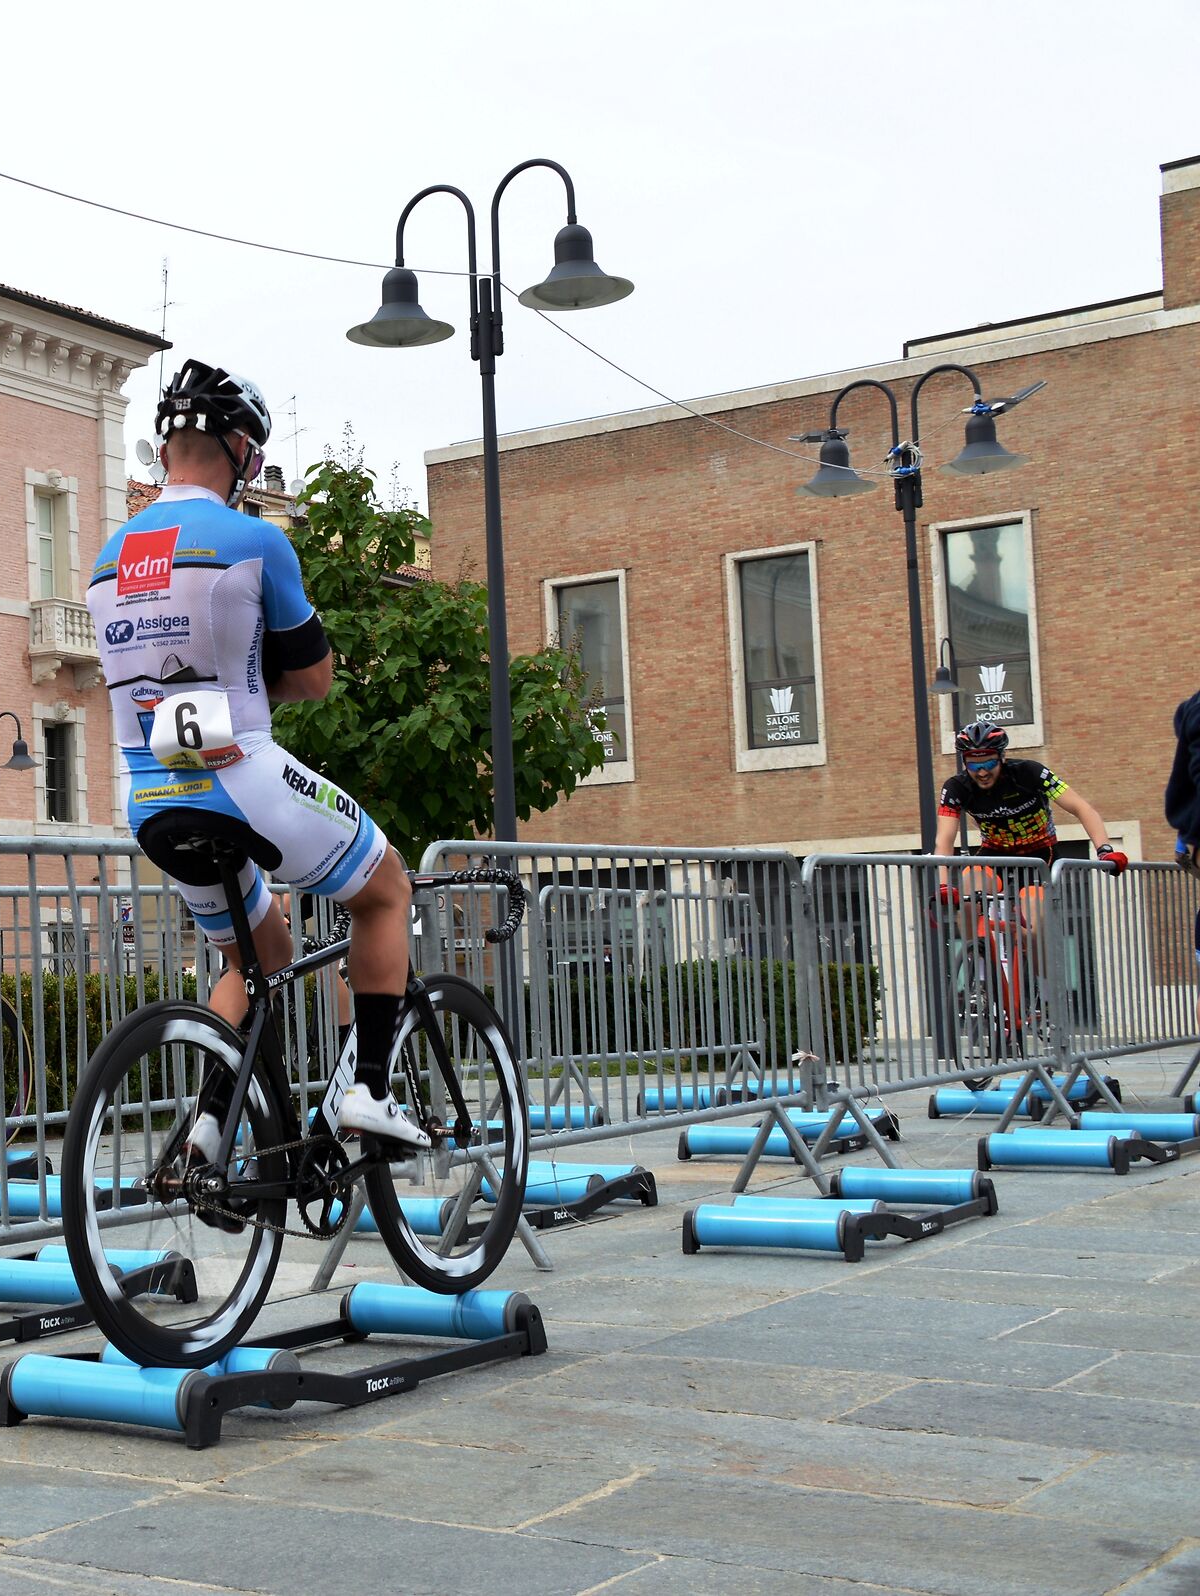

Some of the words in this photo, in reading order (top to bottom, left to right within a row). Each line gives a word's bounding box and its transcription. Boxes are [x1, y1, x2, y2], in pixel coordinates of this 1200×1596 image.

[121, 554, 169, 580] vdm
[136, 614, 190, 632] Assigea
[246, 652, 259, 694] OFFICINA
[975, 693, 1013, 706] SALONE
[766, 714, 800, 726] SALONE
[976, 710, 1014, 722] MOSAICI
[174, 701, 203, 750] 6
[767, 730, 801, 742] MOSAICI
[135, 788, 177, 800] MARIANA
[178, 782, 203, 793] LUIGI
[553, 1211, 568, 1220] Tacx
[39, 1317, 60, 1329] Tacx
[366, 1377, 389, 1393] Tacx
